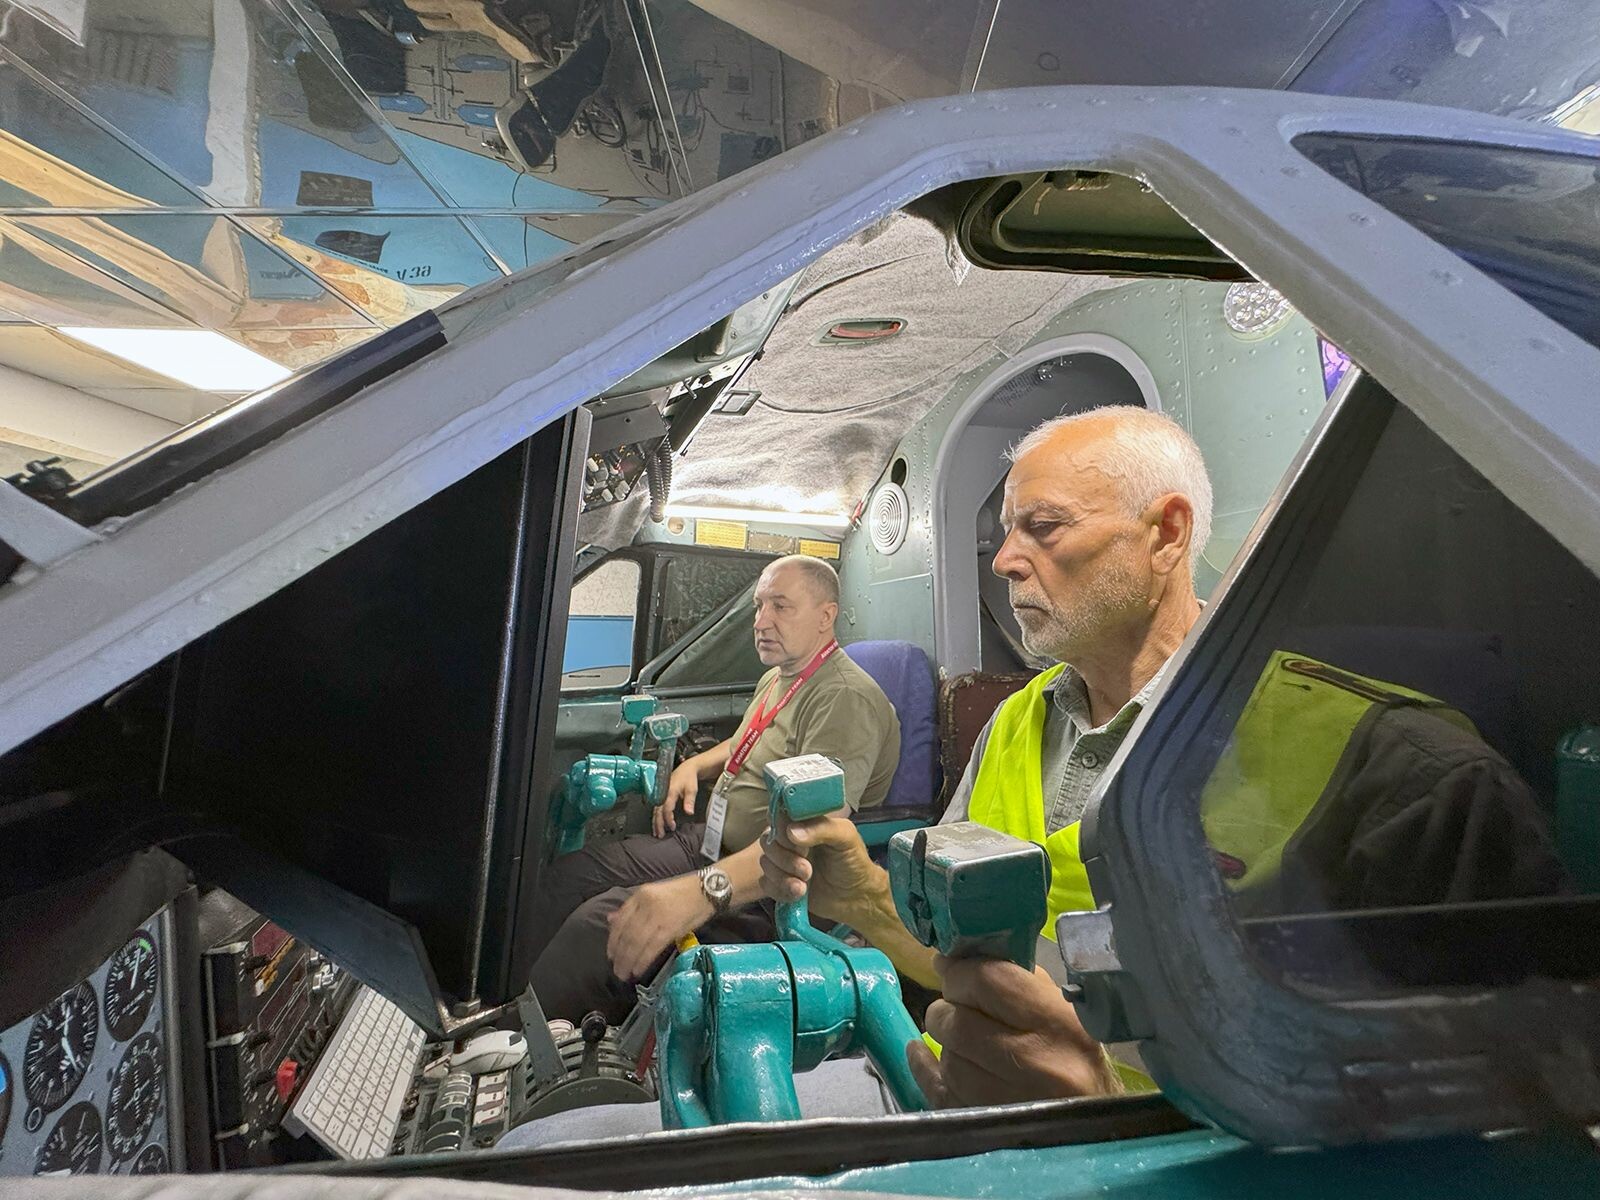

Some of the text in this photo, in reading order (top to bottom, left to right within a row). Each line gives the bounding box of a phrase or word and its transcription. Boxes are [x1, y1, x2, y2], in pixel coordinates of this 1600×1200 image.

[776, 677, 803, 710] AVIATOR TEAM
[735, 742, 750, 764] AVIATOR
[747, 729, 759, 745] TEAM
